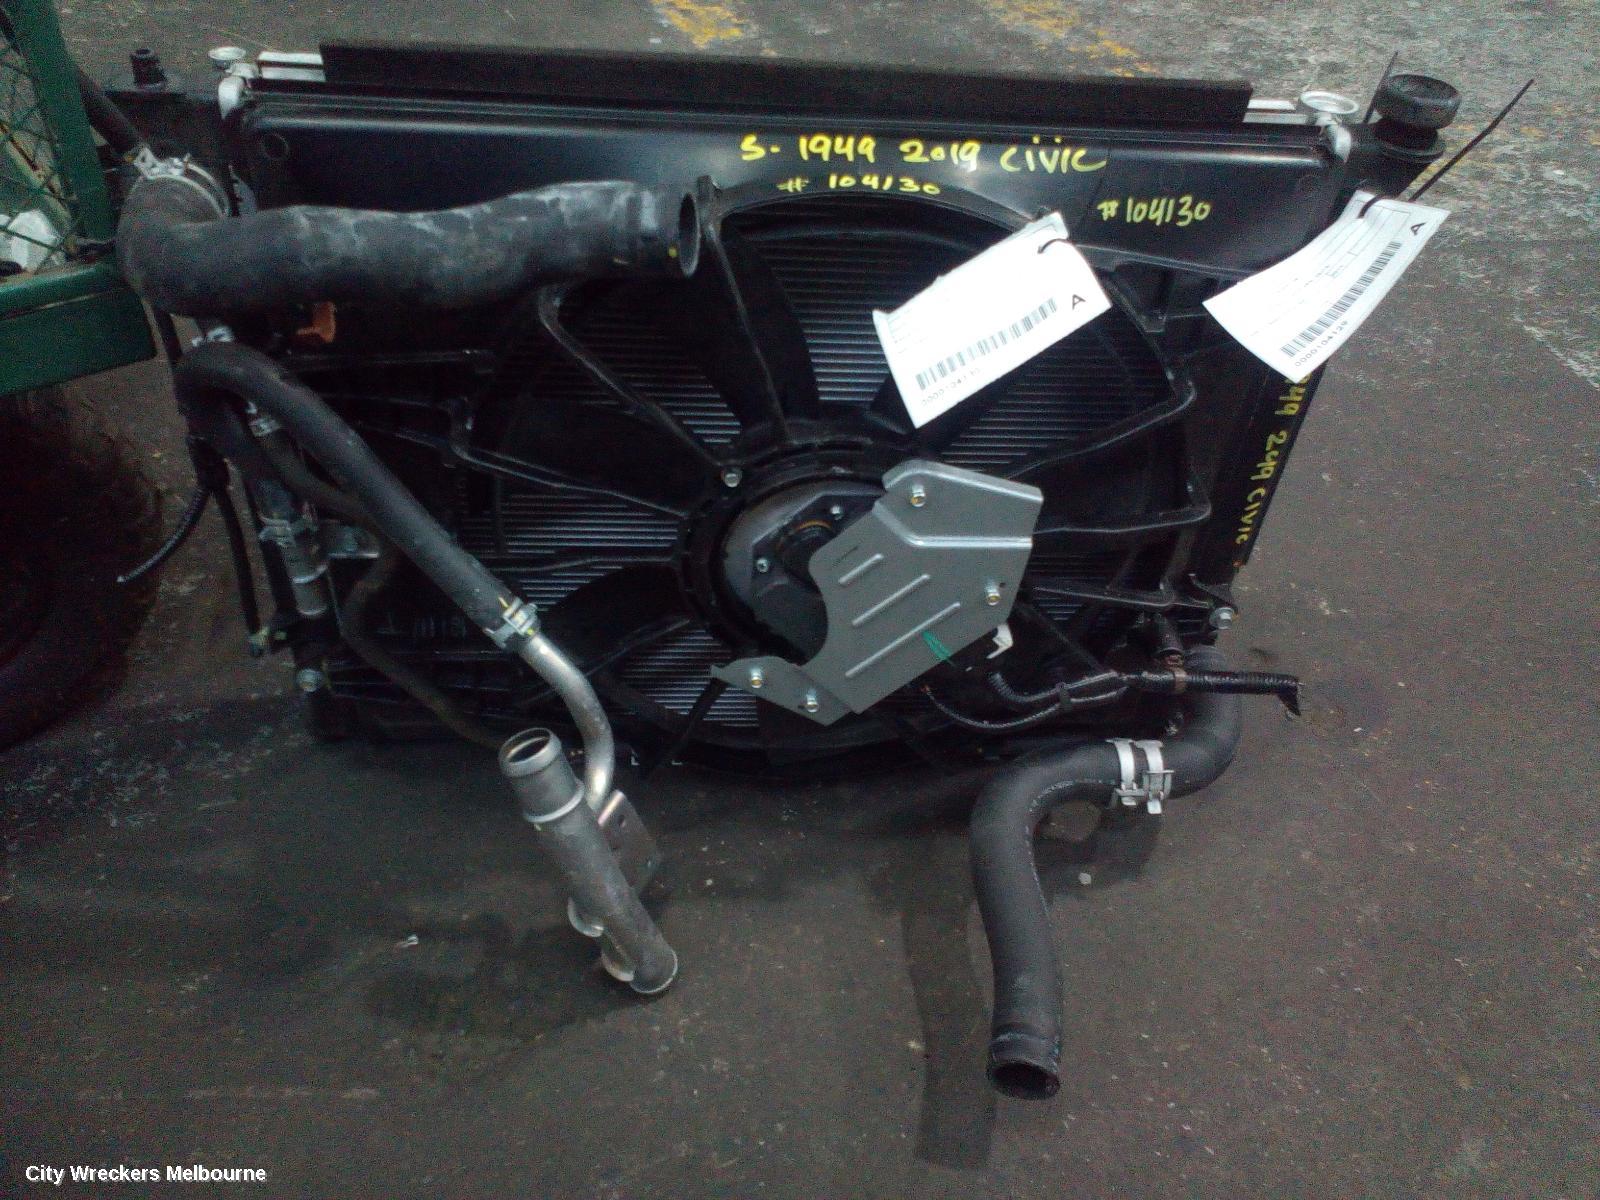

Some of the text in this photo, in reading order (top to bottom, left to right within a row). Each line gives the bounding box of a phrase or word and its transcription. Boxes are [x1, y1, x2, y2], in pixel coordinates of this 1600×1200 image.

[799, 133, 877, 164] 1949
[898, 138, 981, 173] 2019
[829, 173, 940, 196] 104130
[1410, 222, 1425, 236] A
[1071, 294, 1086, 310] A
